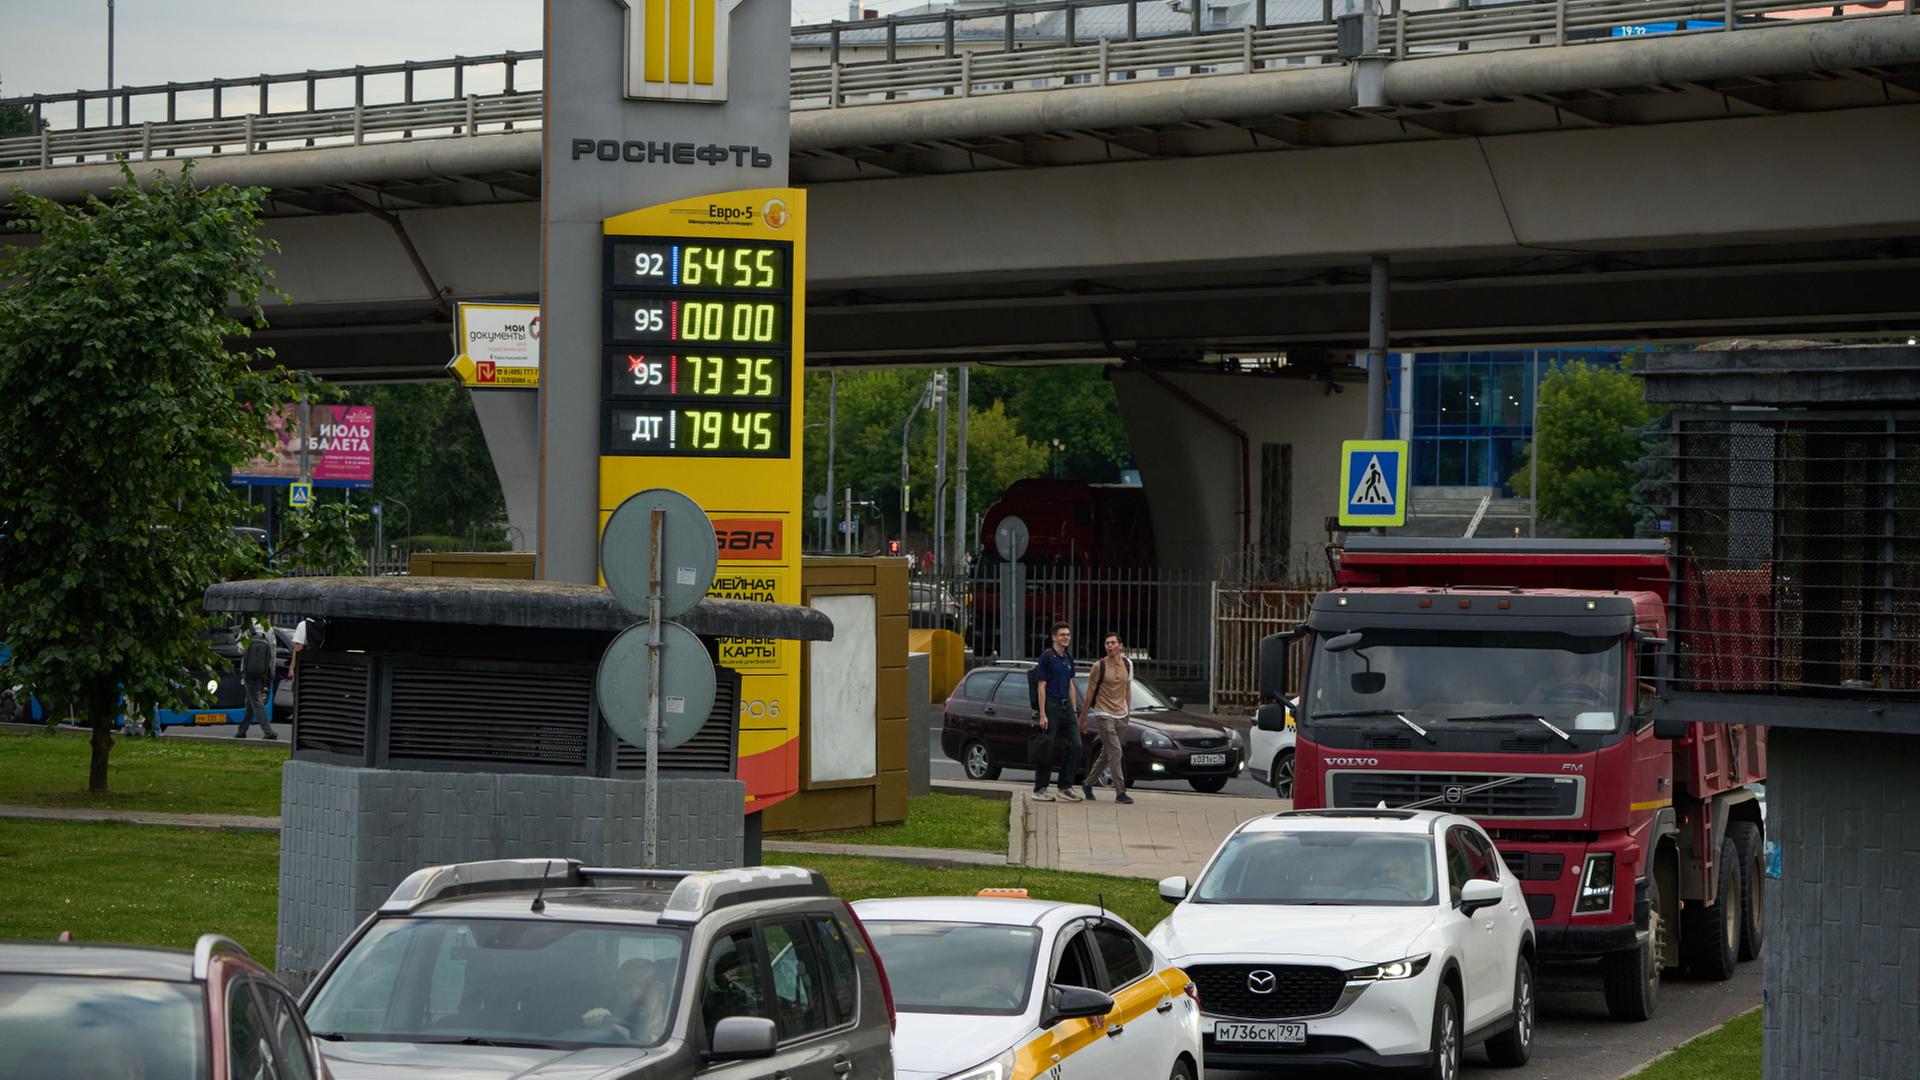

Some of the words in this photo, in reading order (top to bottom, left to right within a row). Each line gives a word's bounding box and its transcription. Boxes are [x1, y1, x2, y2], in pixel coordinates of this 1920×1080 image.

[572, 138, 772, 168] РОСНЕФТЬ
[635, 253, 664, 276] 92
[634, 309, 664, 331] 95
[469, 331, 526, 342] документы
[634, 363, 663, 386] 95
[319, 424, 370, 438] ИЮЛЬ
[631, 416, 663, 441] ДТ
[308, 437, 370, 452] БАЛЕТА
[723, 646, 776, 657] КАРТЫ
[1323, 757, 1379, 766] VOLVO
[1562, 763, 1584, 771] FM
[1279, 1025, 1301, 1037] 797
